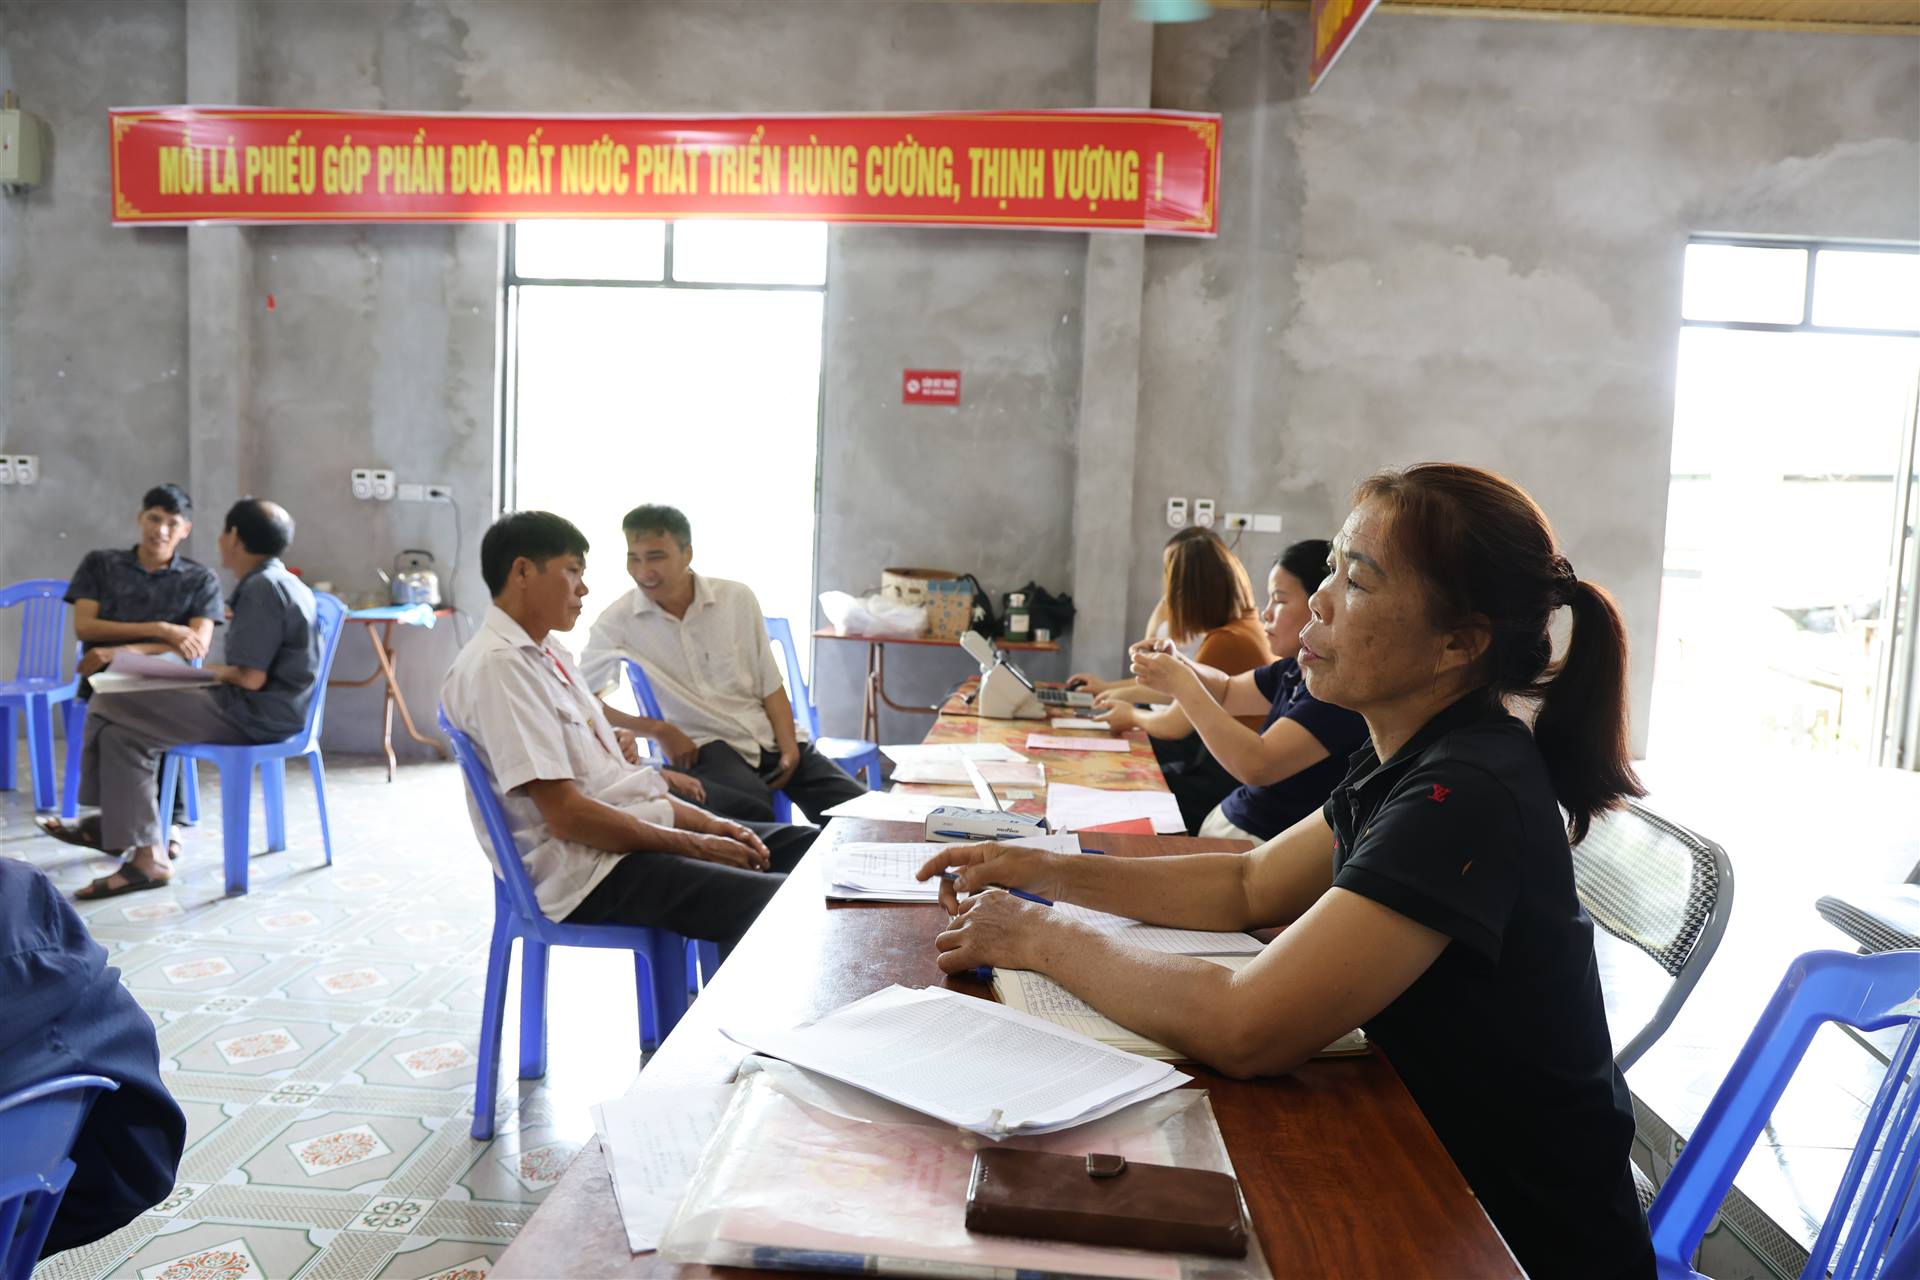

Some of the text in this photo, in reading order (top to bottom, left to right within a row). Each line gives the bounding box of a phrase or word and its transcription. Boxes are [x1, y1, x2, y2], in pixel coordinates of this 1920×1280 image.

[245, 129, 316, 195] PHIẾU
[322, 134, 371, 195] GÓP
[450, 140, 501, 196] ĐƯA
[506, 127, 555, 196] ĐẤT
[560, 134, 630, 196] NƯỚC
[635, 136, 700, 196] PHÁT
[707, 125, 781, 196] TRIỂN
[787, 134, 858, 196] HÙNG
[865, 134, 961, 203] CƯỜNG,
[968, 147, 1045, 209] THỊNH
[1052, 145, 1140, 211] VƯỢNG
